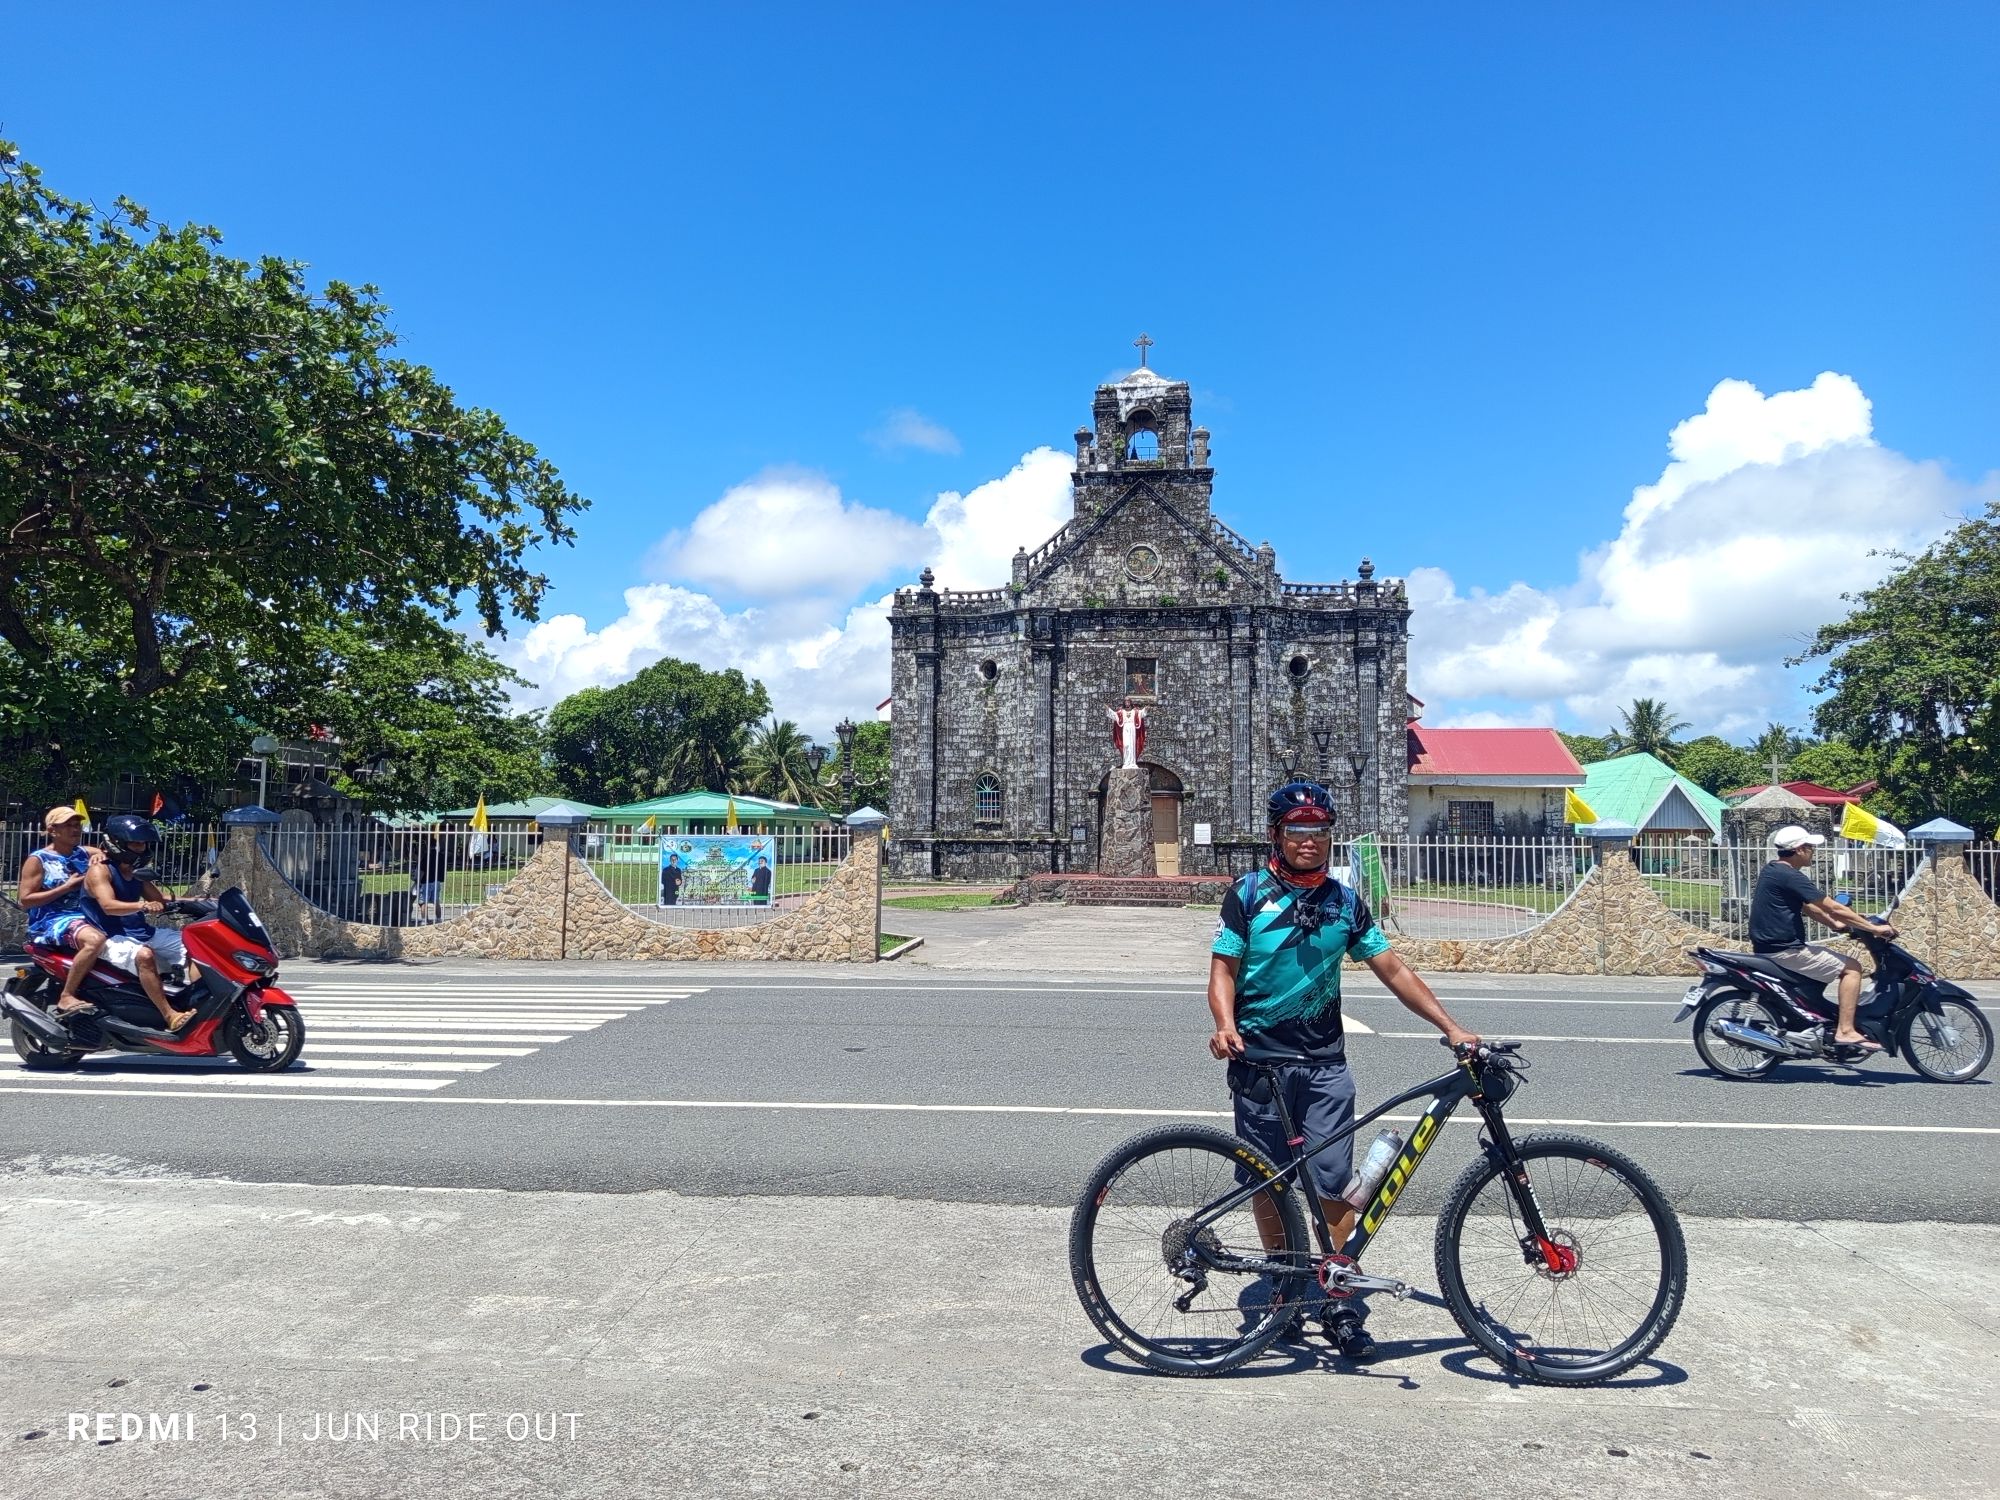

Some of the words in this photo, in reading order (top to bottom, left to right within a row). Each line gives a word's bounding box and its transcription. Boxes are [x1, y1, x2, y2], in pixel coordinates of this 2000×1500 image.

[1235, 1149, 1283, 1192] MAXXS
[1623, 1323, 1660, 1362] ROCKET
[1661, 1292, 1676, 1320] RON
